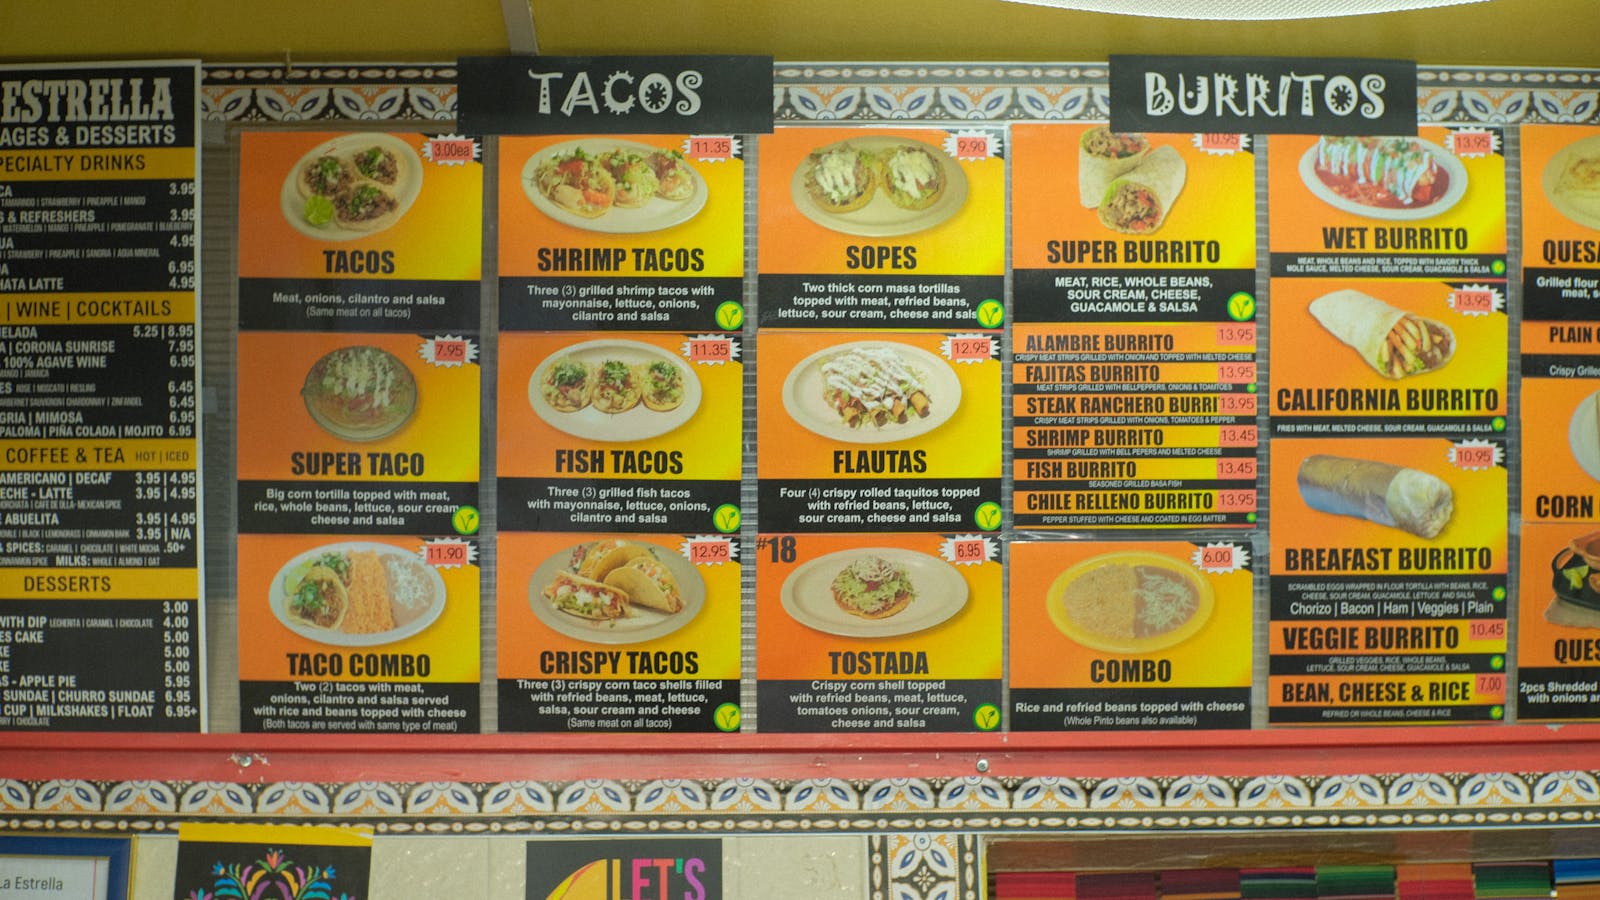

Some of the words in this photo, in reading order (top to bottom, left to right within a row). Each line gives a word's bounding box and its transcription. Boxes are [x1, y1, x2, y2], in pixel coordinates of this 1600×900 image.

[1, 78, 174, 122] ESTRELLA
[528, 69, 704, 117] TACOS
[1145, 70, 1386, 119] BURRITOS
[55, 127, 69, 145] &
[77, 125, 175, 144] DESSERTS
[1205, 134, 1238, 146] 10.95
[1455, 134, 1490, 148] 13.95
[435, 143, 469, 157] 3.00ea
[694, 141, 730, 153] 11.35
[958, 138, 986, 154] 9.90
[81, 155, 145, 170] DRINKS
[8, 211, 16, 223] &
[20, 210, 95, 223] REFRESHERS
[170, 209, 194, 223] 3.95
[1323, 227, 1368, 249] WET
[1375, 228, 1467, 249] BURRITO
[847, 246, 916, 269] SOPES
[1047, 241, 1117, 263] SUPER
[1124, 241, 1219, 263] BURRITO
[323, 250, 394, 273] TACOS
[538, 248, 626, 271] SHRIMP
[632, 248, 704, 271] TACOS
[528, 285, 558, 295] Three
[562, 285, 576, 297] (3)
[579, 285, 613, 297] grilled
[617, 286, 655, 296] shrimp
[692, 286, 714, 295] with
[803, 283, 825, 292] Two
[828, 283, 855, 292] thick
[886, 285, 915, 293] masa
[919, 284, 960, 293] tortillas
[273, 293, 301, 304] Meat,
[305, 295, 345, 303] onions,
[348, 294, 389, 304] cilantro
[393, 295, 413, 304] and
[417, 296, 445, 304] salsa
[1457, 294, 1490, 307] 13.95
[16, 302, 59, 317] WINE
[77, 301, 171, 316] COCKTAILS
[133, 325, 158, 337] 5.25
[168, 326, 193, 338] 8.95
[1219, 329, 1253, 340] 13.95
[1550, 327, 1592, 342] PLAIN
[16, 341, 62, 353] CORONA
[66, 341, 114, 353] SUNRISE
[169, 340, 194, 353] 7.95
[693, 344, 728, 355] 11.35
[954, 342, 989, 354] 12.95
[1027, 335, 1100, 351] ALAMBRE
[1105, 335, 1173, 351] BURRITO
[437, 344, 463, 357] 7.95
[1026, 366, 1085, 382] FAJITAS
[1091, 366, 1159, 381] BURRITO
[1220, 367, 1254, 378] 13.95
[1027, 397, 1076, 413] STEAK
[1081, 397, 1164, 413] RANCHERO
[1170, 397, 1217, 413] BURRI
[1220, 398, 1254, 409] 13.95
[1278, 389, 1400, 411] CALIFORNIA
[1407, 389, 1498, 411] BURRITO
[0, 426, 40, 437] PALOMA
[49, 425, 73, 436] PIÑA
[76, 426, 116, 436] COLADA
[125, 426, 163, 436] MOJITO
[169, 425, 191, 436] 6.95
[1027, 430, 1089, 446] SHRIMP
[1095, 430, 1163, 445] BURRITO
[1222, 431, 1255, 442] 13.45
[6, 448, 68, 463] COFFEE
[76, 448, 87, 463] &
[94, 448, 124, 463] TEA
[136, 451, 155, 461] HOT
[166, 451, 189, 461] ICED
[556, 450, 604, 473] FISH
[611, 450, 682, 474] TACOS
[834, 450, 926, 473] FLAUTAS
[1458, 450, 1490, 462] 10.95
[291, 452, 361, 475] SUPER
[367, 453, 424, 476] TACO
[1028, 462, 1062, 478] FISH
[1067, 462, 1136, 478] BURRITO
[1219, 463, 1253, 474] 13.45
[0, 473, 65, 484] AMERICANO
[76, 472, 111, 484] DECAF
[136, 472, 160, 484] 3.95
[170, 472, 195, 485] 4.95
[780, 488, 806, 497] Four
[809, 488, 820, 499] (4)
[823, 490, 857, 499] crispy
[860, 488, 891, 497] rolled
[894, 488, 938, 497] taquitos
[942, 487, 980, 498] topped
[1220, 494, 1254, 506] 13.95
[1028, 494, 1071, 510] CHILE
[1076, 494, 1139, 509] RELLENO
[1145, 493, 1212, 509] BURRITO
[1536, 495, 1593, 518] CORN
[429, 548, 463, 559] 11.90
[692, 545, 727, 557] 12.95
[757, 536, 796, 563] #18
[958, 543, 980, 557] 6.95
[1203, 551, 1231, 563] 6.00
[1286, 548, 1392, 570] BREAFAST
[1399, 548, 1491, 570] BURRITO
[24, 576, 110, 591] DESSERTS
[1290, 602, 1331, 614] Chorizo
[1341, 602, 1374, 614] Bacon
[1384, 602, 1408, 614] Ham
[1418, 602, 1459, 616] Veggies
[1468, 601, 1493, 613] Plain
[1471, 623, 1503, 635] 10.45
[1283, 627, 1358, 649] VEGGIE
[1365, 627, 1458, 649] BURRITO
[287, 653, 342, 676] TACO
[350, 654, 430, 676] COMBO
[540, 651, 621, 674] CRISPY
[627, 652, 698, 674] TACOS
[829, 652, 928, 674] TOSTADA
[1091, 660, 1171, 682] COMBO
[1481, 677, 1501, 691] 7.00
[1520, 683, 1545, 695] 2pcs
[1548, 682, 1597, 691] Shredded
[4, 690, 48, 701] SUNDAE
[58, 691, 105, 702] CHURRO
[109, 691, 154, 702] SUNDAE
[165, 691, 190, 702] 6.95
[1283, 683, 1333, 705] BEAN,
[1339, 683, 1405, 702] CHEESE
[1411, 685, 1423, 701] &
[1429, 682, 1469, 701] RICE
[4, 704, 26, 715] CUP
[37, 705, 108, 716] MILKSHAKES
[118, 706, 153, 717] FLOAT
[165, 706, 198, 717] 6.95+
[15, 877, 63, 890] Estrella
